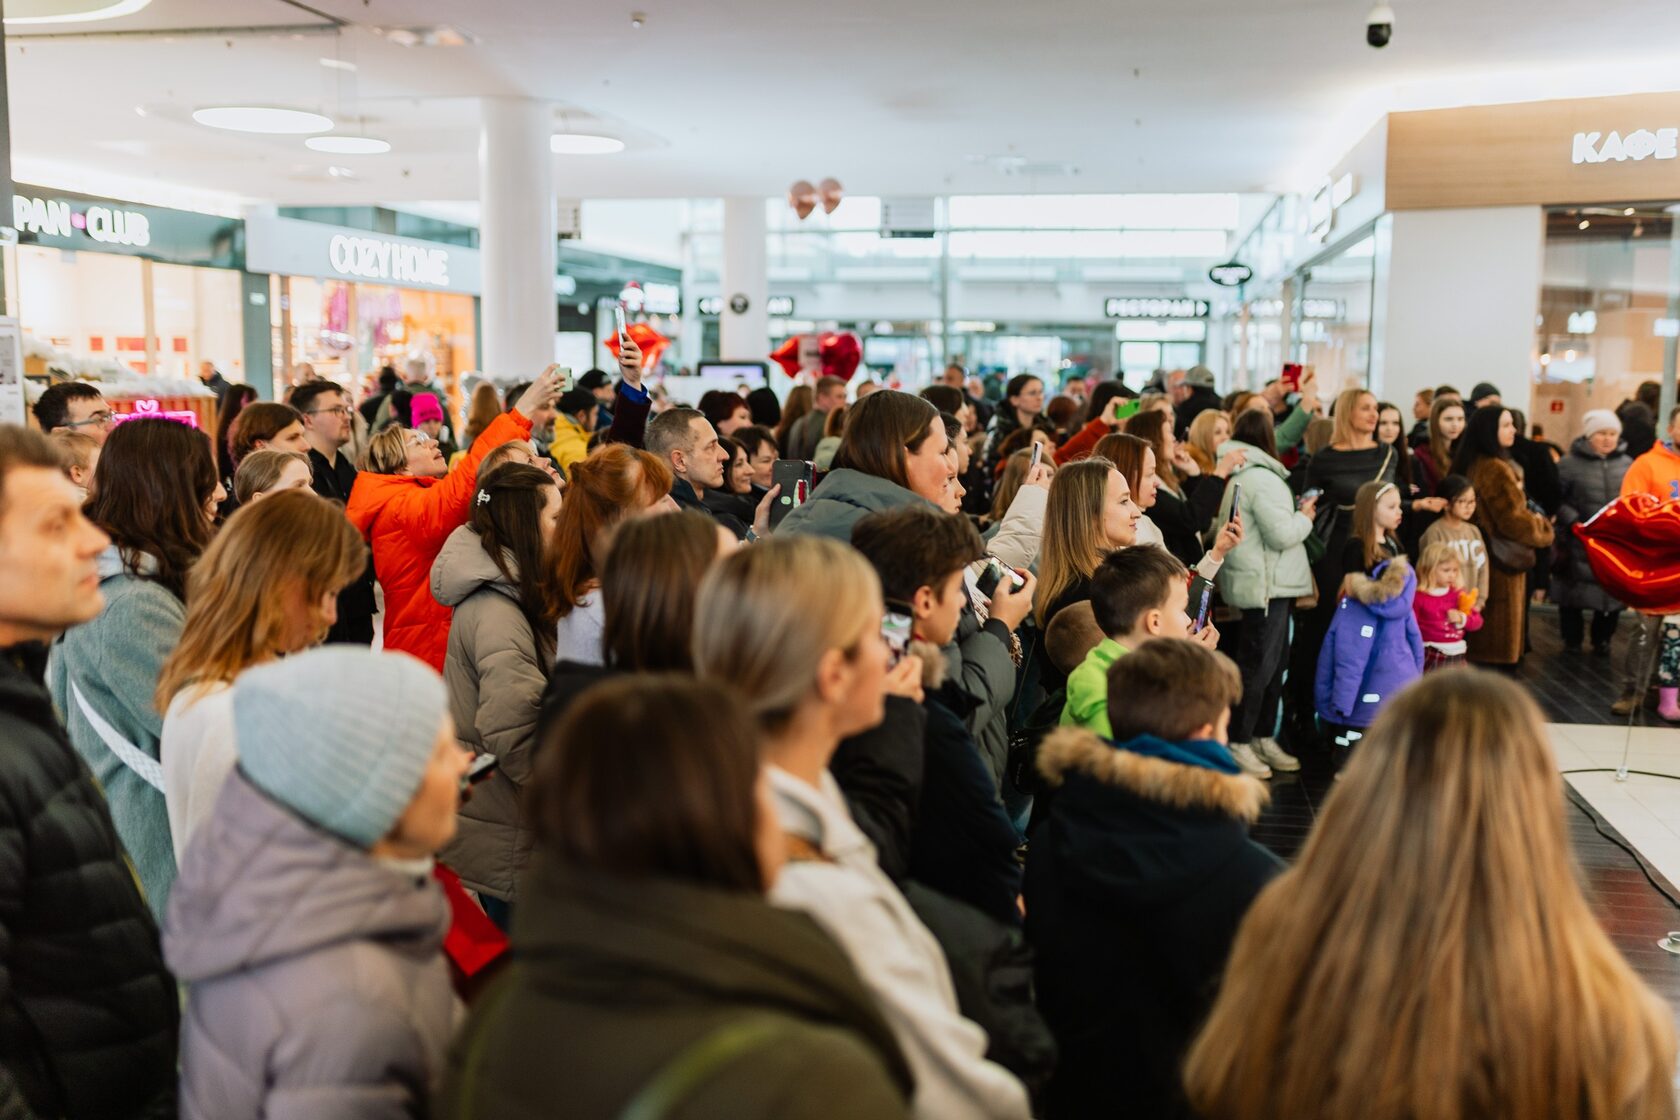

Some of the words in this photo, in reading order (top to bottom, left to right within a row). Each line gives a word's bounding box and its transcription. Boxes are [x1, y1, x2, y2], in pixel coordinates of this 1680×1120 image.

[1572, 128, 1678, 164] КАФЕ
[12, 194, 72, 238] PAN
[86, 206, 151, 247] CLUB
[329, 234, 391, 279] COZY
[391, 243, 450, 286] HOME
